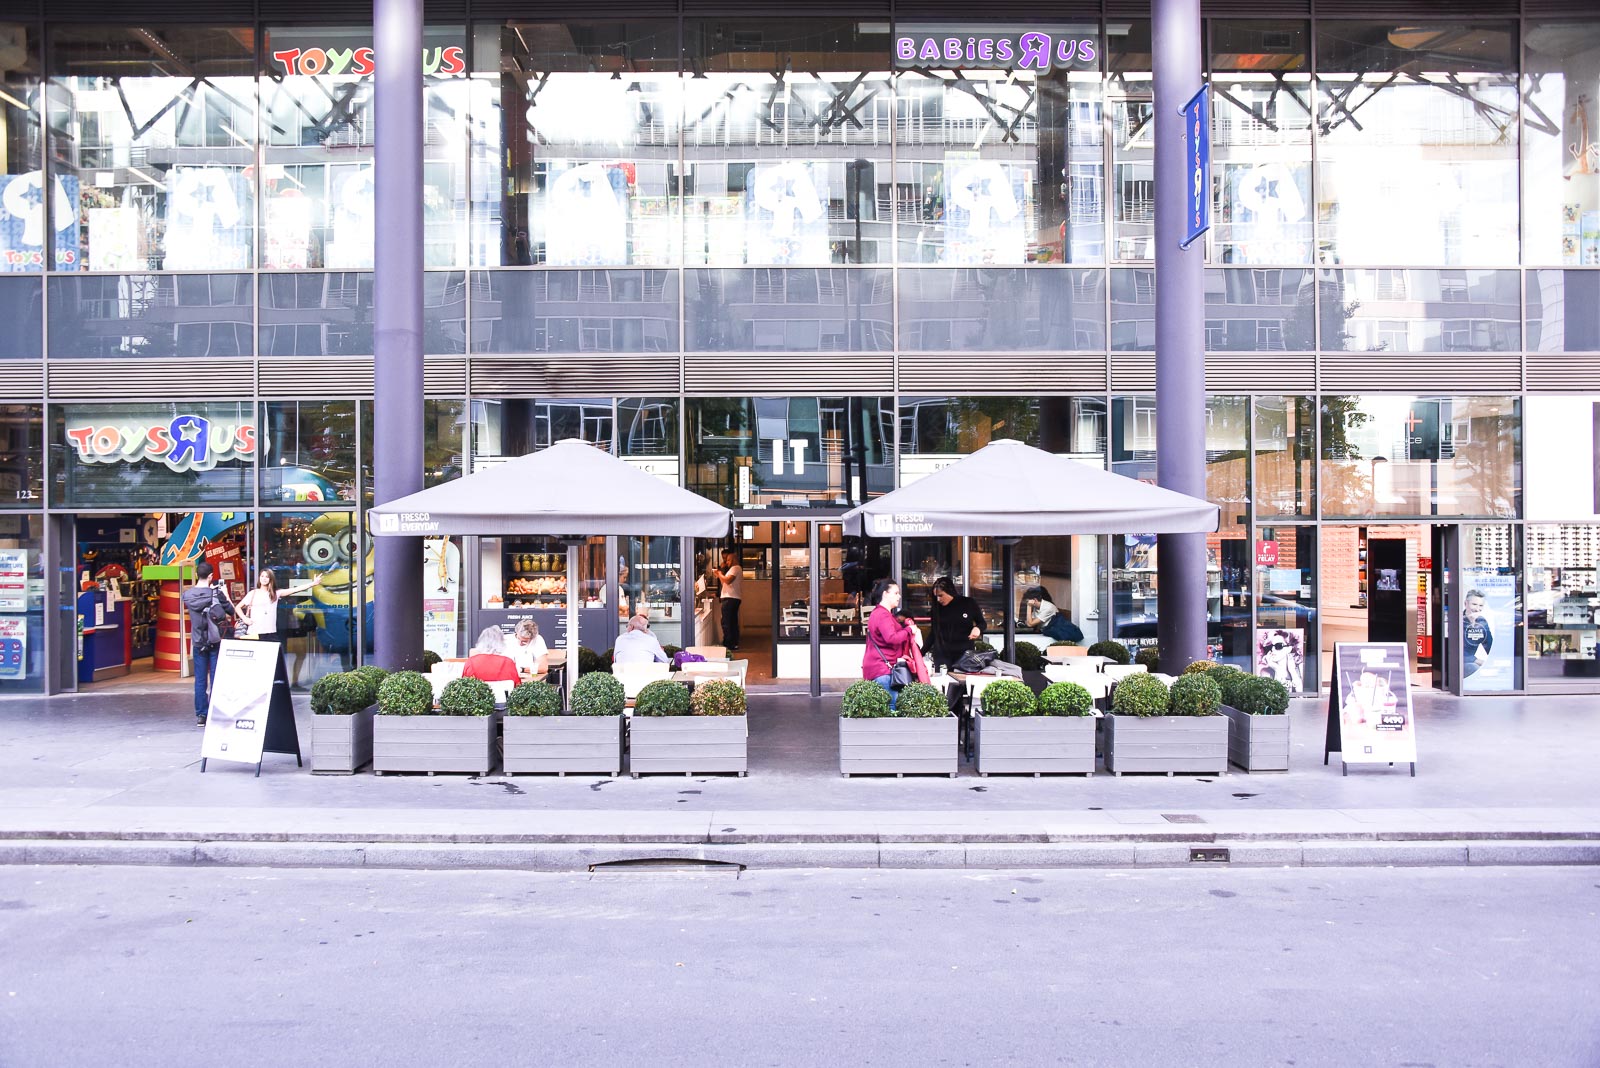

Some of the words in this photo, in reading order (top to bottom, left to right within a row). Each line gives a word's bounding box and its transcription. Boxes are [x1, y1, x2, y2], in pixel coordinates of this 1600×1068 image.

[1056, 39, 1096, 61] US
[274, 47, 375, 76] TOYS
[67, 426, 170, 456] TOYS
[209, 425, 255, 455] US
[772, 439, 809, 475] IT
[16, 490, 32, 499] 123
[400, 512, 430, 522] FRESCO
[895, 513, 924, 523] FRESCO
[400, 521, 439, 532] EVERYDAY
[895, 522, 934, 532] EVERYDAY
